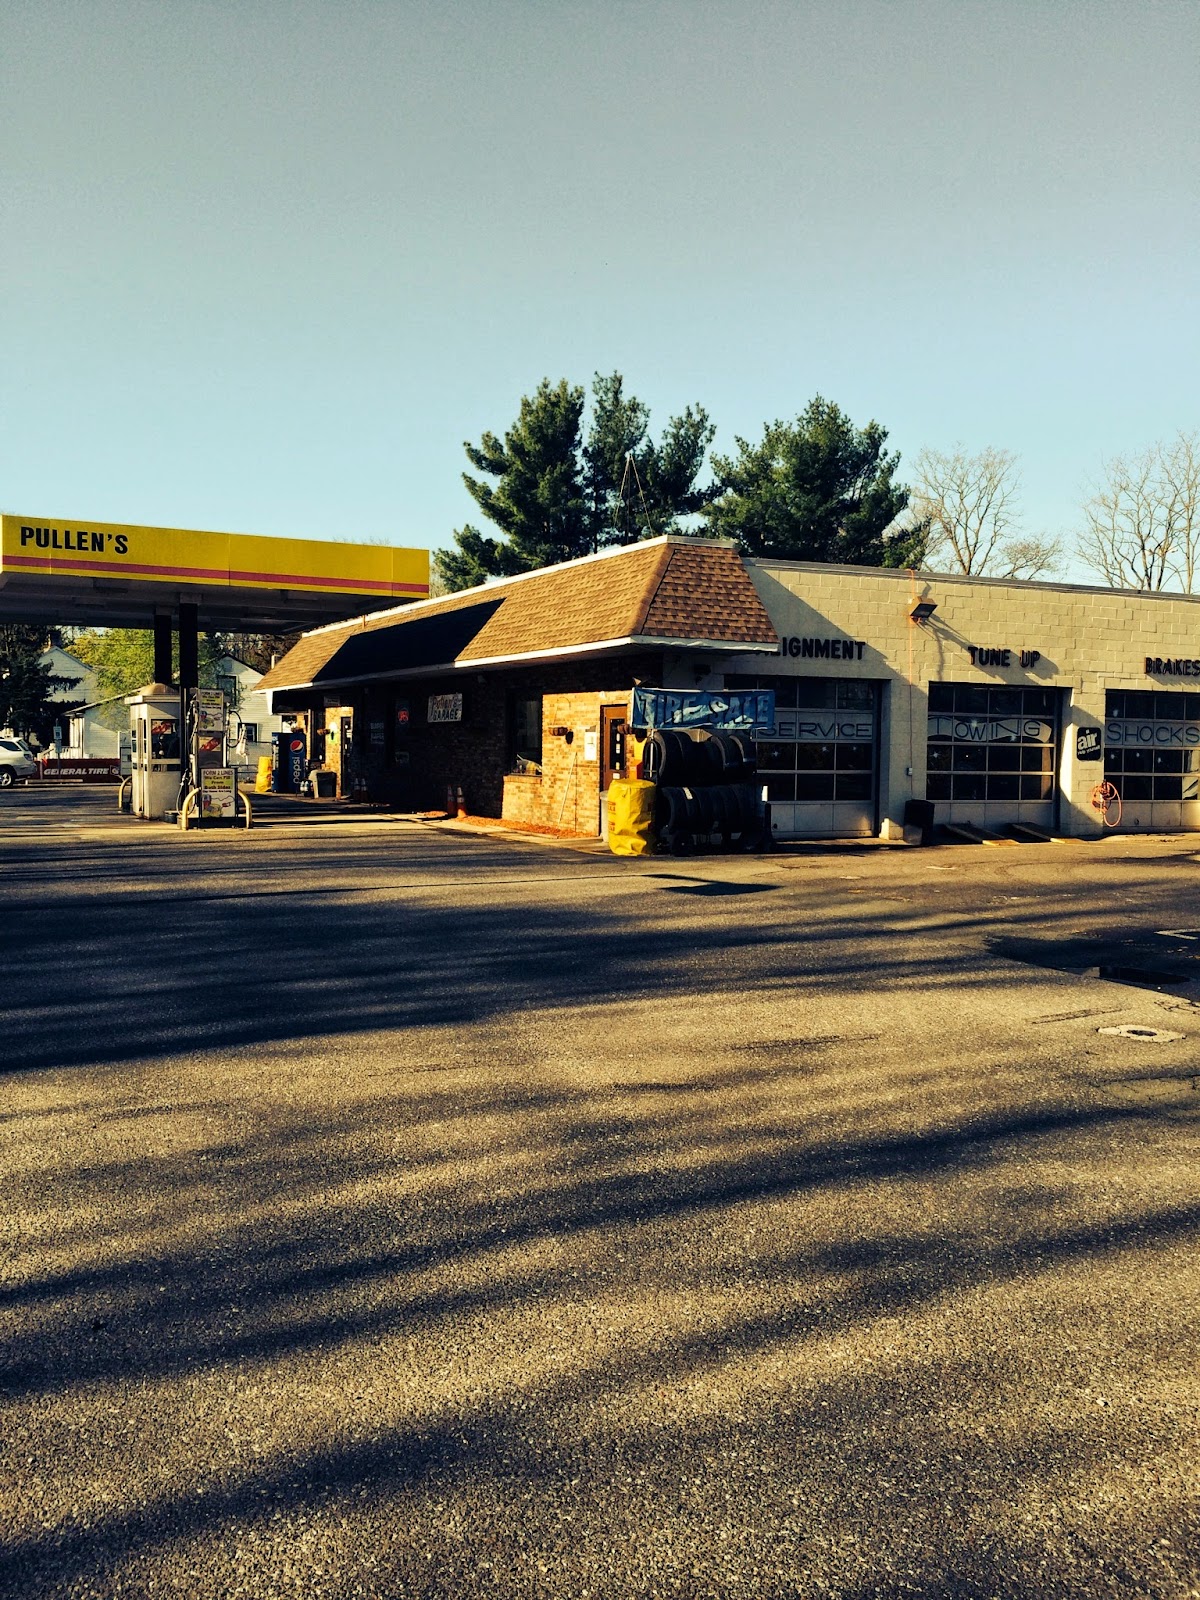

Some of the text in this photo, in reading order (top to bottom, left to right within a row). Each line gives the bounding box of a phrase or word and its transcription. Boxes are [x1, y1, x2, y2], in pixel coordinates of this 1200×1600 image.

[20, 526, 128, 555] PULLEN'S
[968, 646, 1041, 668] TUNE UP
[1144, 656, 1200, 677] BRAKES
[433, 708, 459, 721] GARAGE
[639, 691, 770, 727] TIRE SALE
[927, 715, 1041, 741] TOWING
[1106, 722, 1200, 744] SHOCKS
[1077, 729, 1098, 750] air
[43, 768, 88, 776] GENERAL
[292, 756, 301, 784] pepsi
